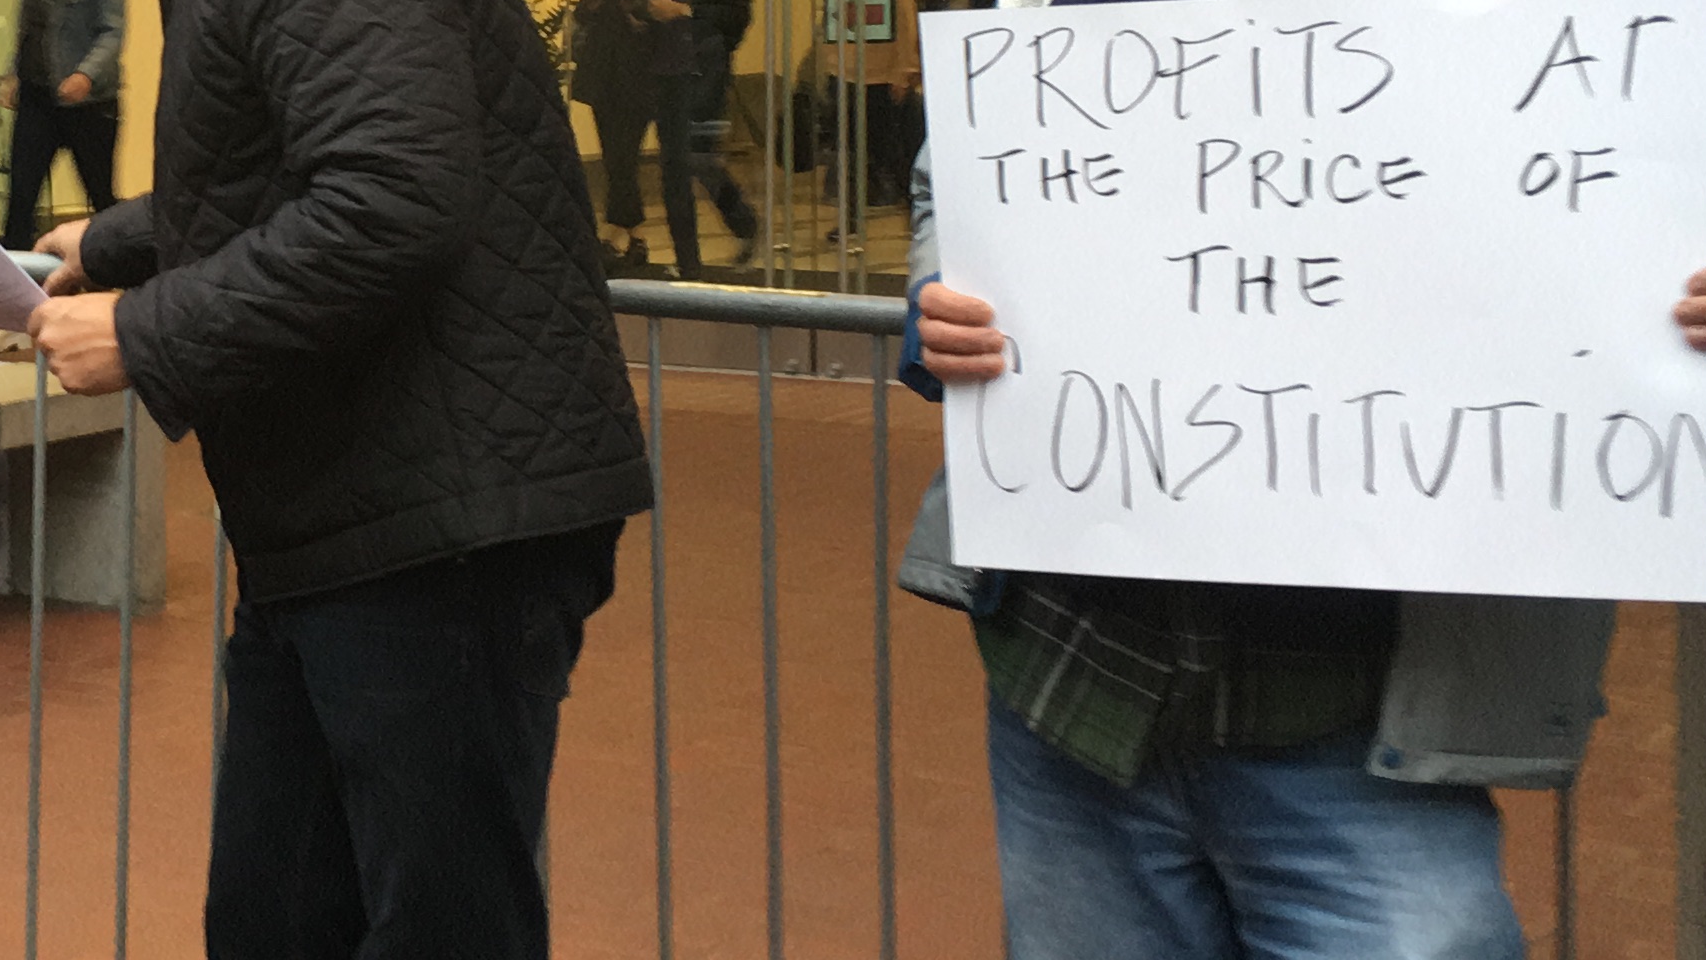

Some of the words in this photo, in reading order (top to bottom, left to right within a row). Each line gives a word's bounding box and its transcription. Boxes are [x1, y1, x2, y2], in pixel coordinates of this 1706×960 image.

[1511, 14, 1677, 113] AT
[977, 147, 1125, 205] THE
[1517, 146, 1621, 213] OF
[1163, 244, 1345, 316] THE
